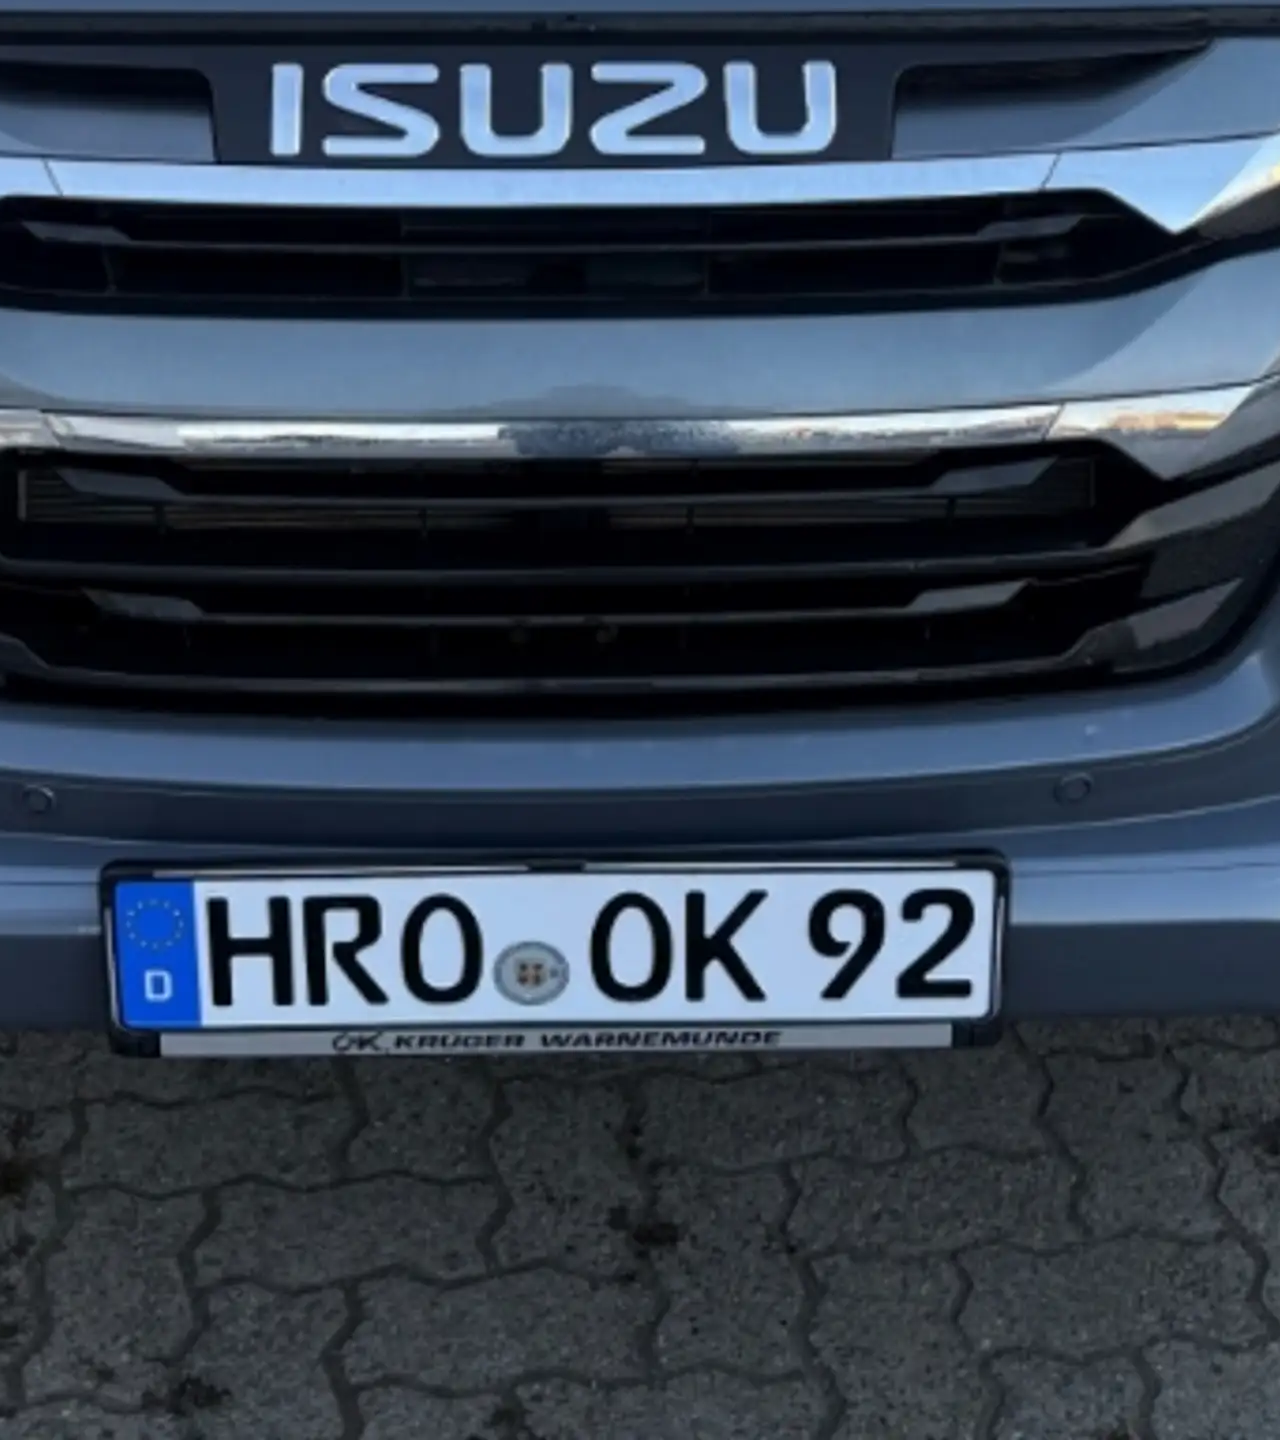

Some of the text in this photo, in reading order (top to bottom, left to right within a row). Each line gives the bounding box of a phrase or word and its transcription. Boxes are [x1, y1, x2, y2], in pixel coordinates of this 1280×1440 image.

[270, 60, 837, 157] ISUZU
[144, 969, 173, 1002] D
[207, 887, 975, 1006] HRO OK 92
